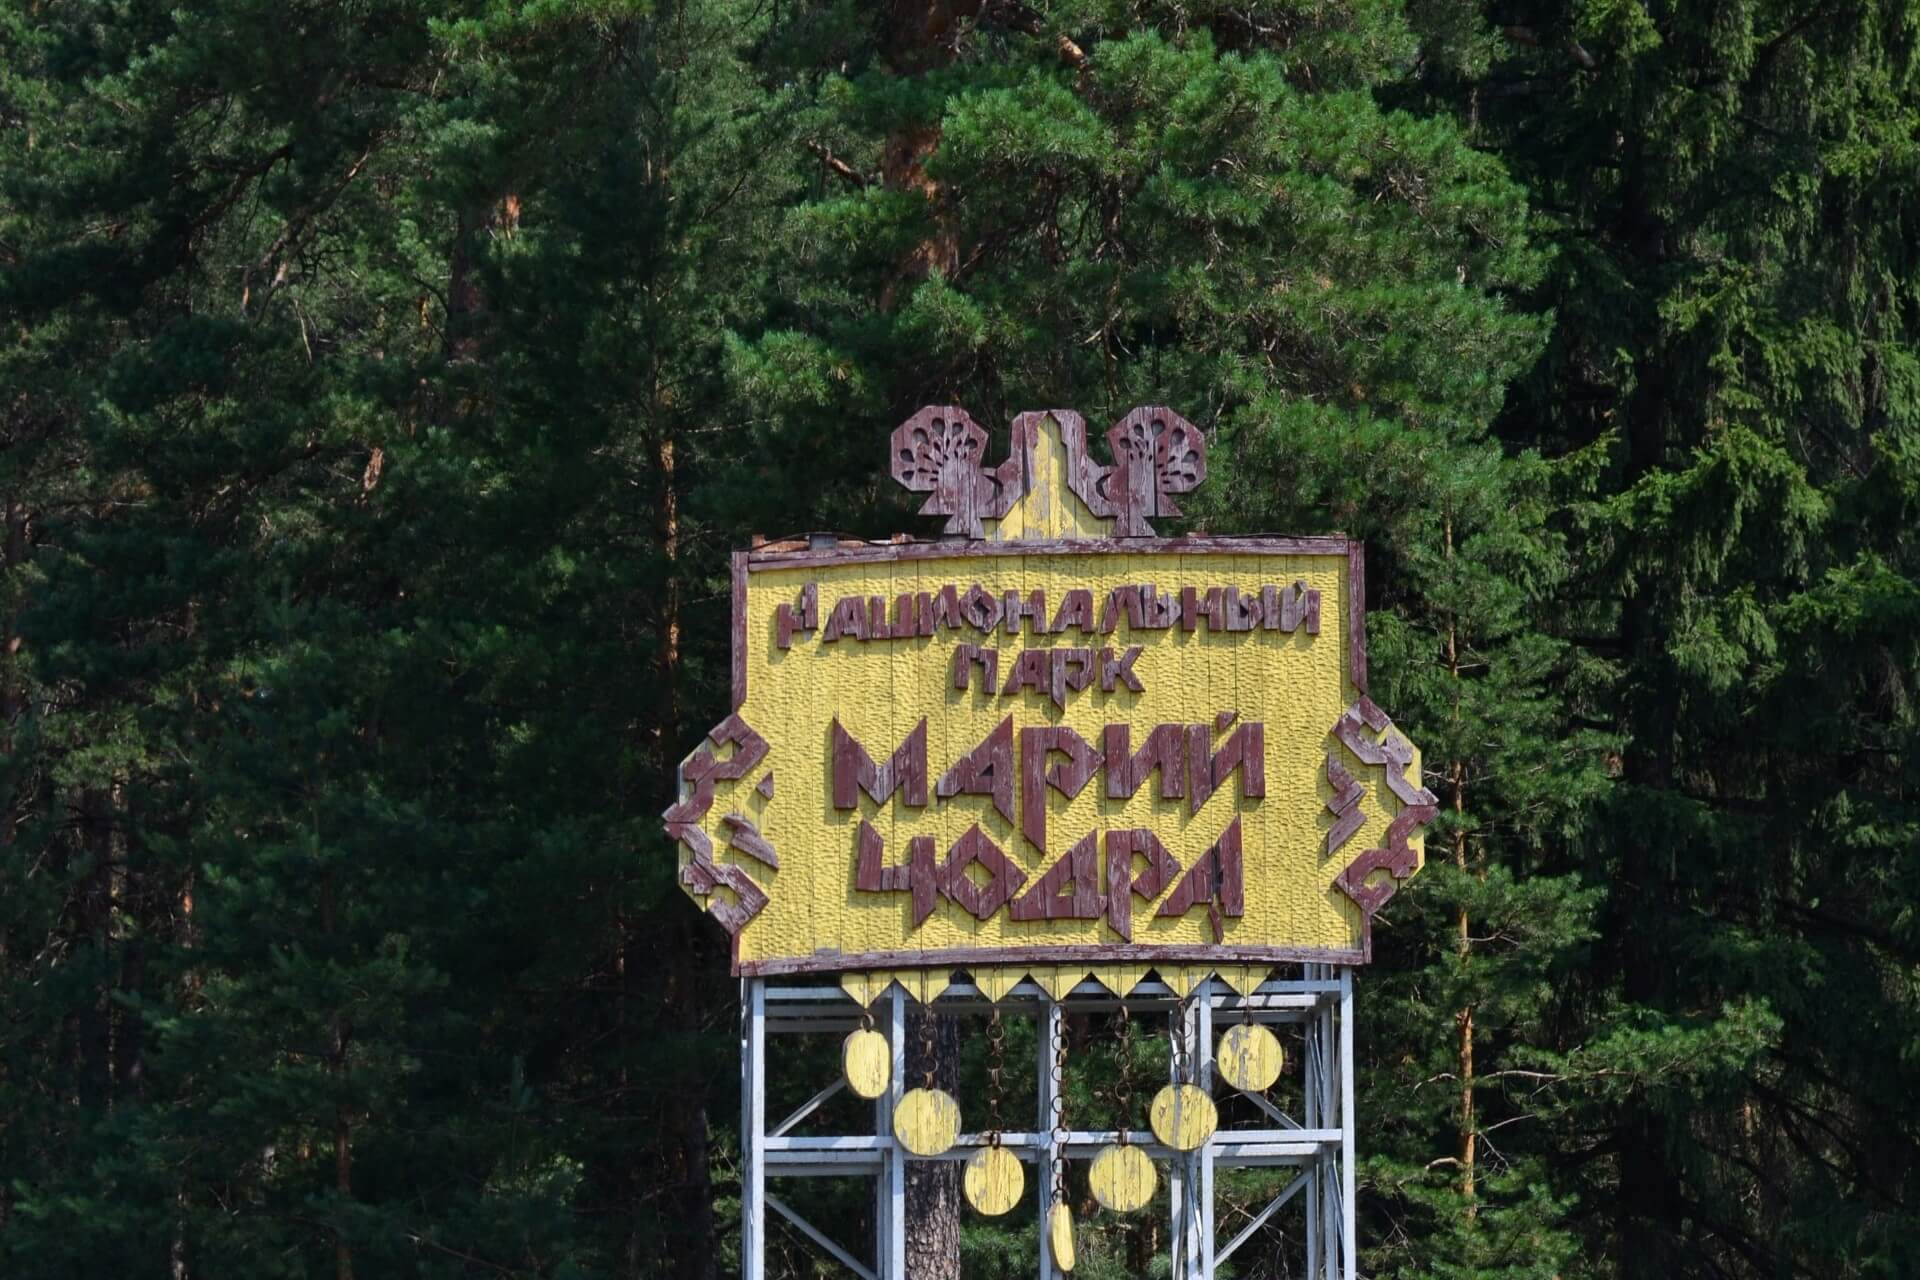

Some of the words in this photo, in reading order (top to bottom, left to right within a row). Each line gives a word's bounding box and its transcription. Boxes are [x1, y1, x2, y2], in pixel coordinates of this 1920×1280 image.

[777, 581, 1321, 649] НАЦИОНАЛЬНЫЙ
[954, 644, 1145, 711] ПАРК
[832, 712, 1265, 855] МАРИЙ
[855, 816, 1244, 943] ЧОДРА
